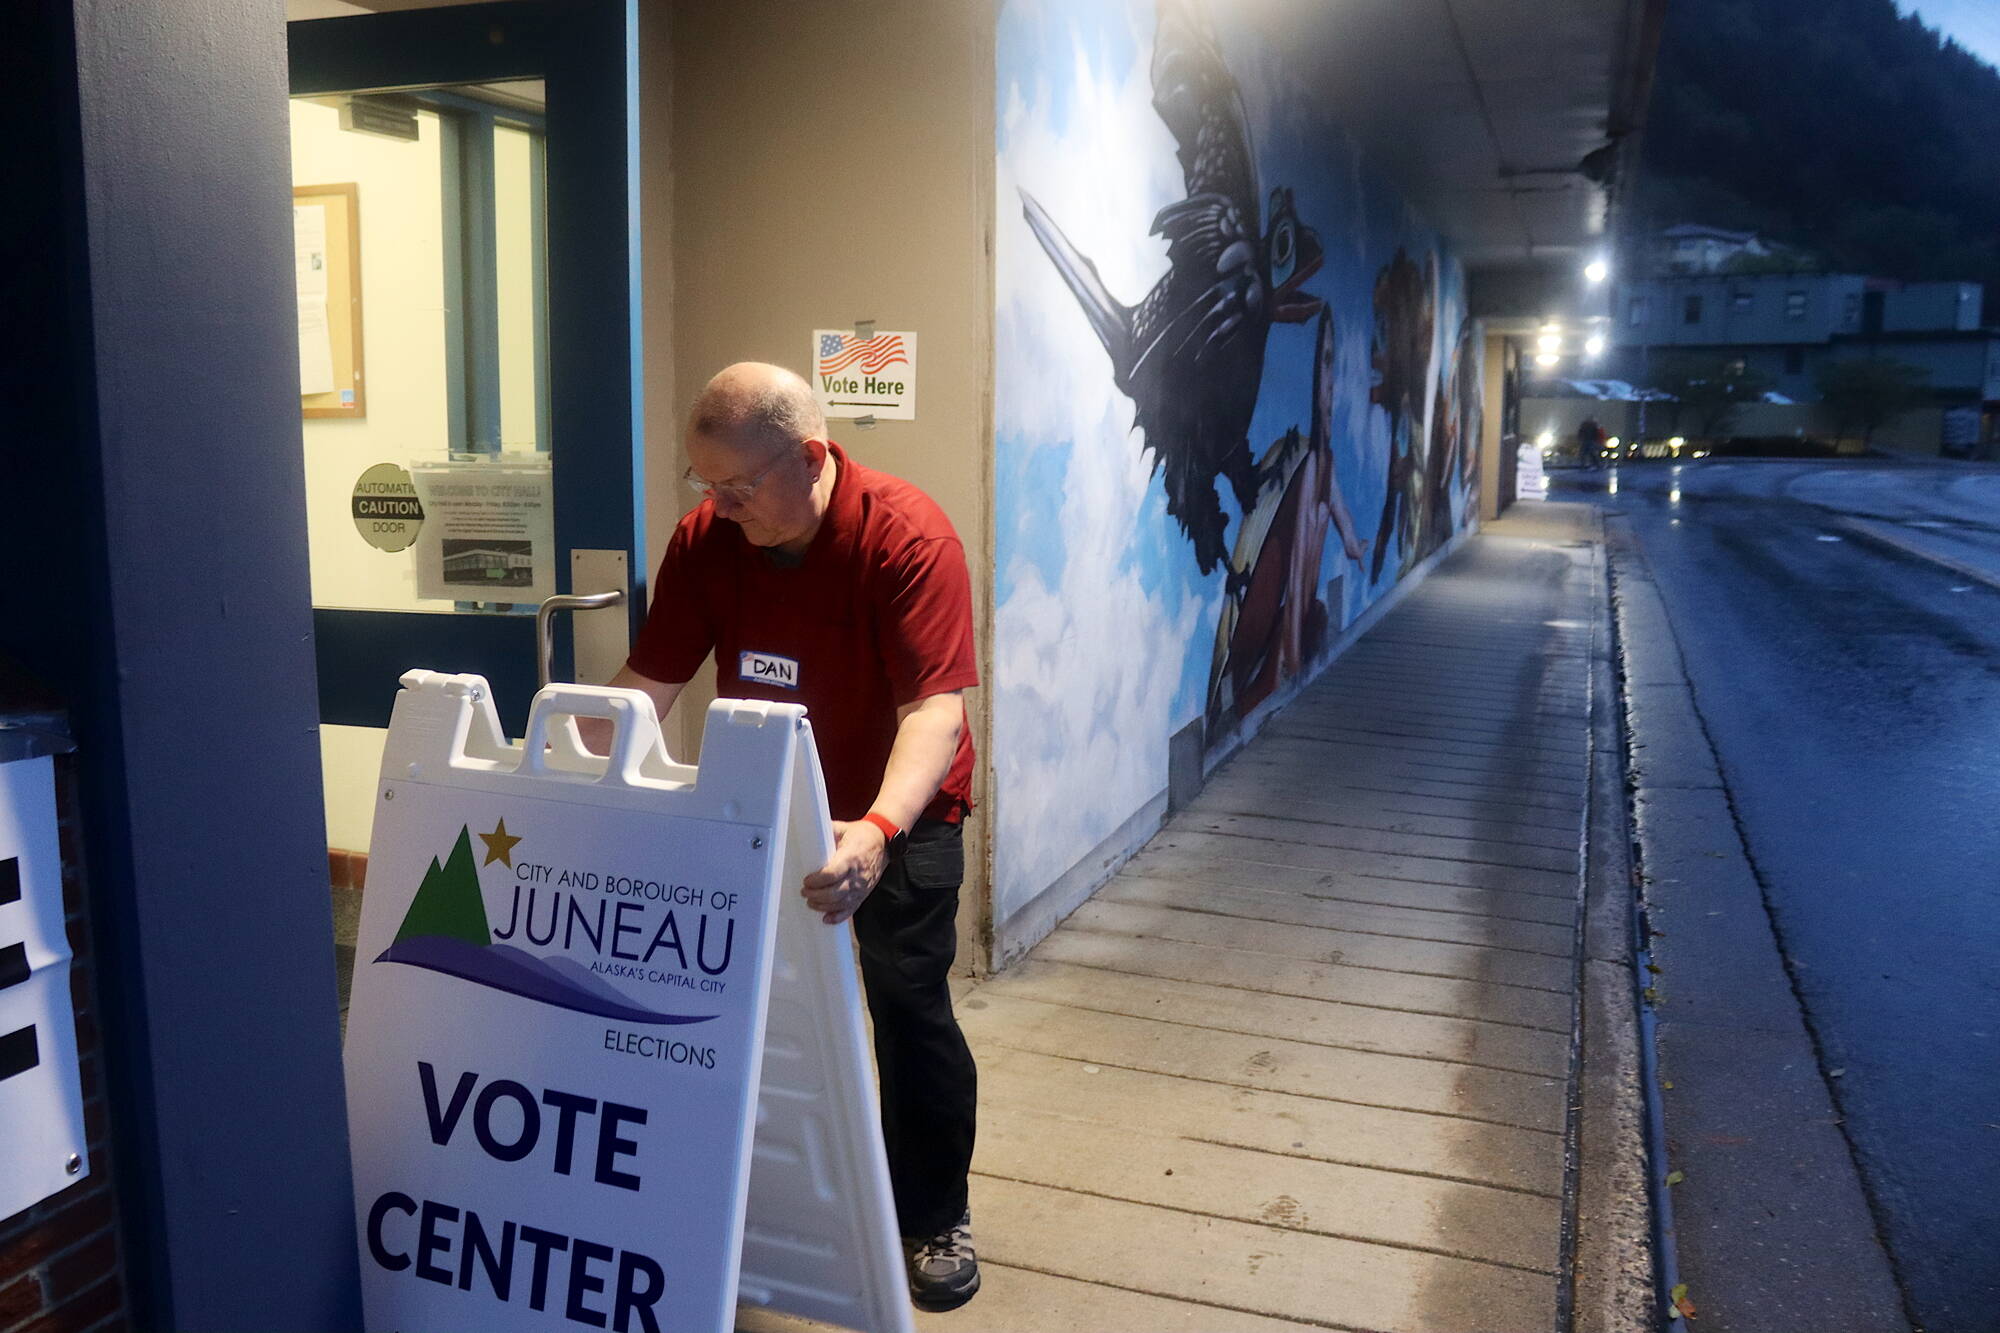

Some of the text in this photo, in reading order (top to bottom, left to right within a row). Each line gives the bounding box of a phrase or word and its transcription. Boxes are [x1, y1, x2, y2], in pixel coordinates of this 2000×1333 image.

[821, 375, 905, 395] Vote Here
[358, 500, 419, 515] CAUTION
[372, 521, 406, 534] DOOR
[753, 658, 792, 681] DAN
[516, 862, 738, 912] CITY AND BOROUGH OF
[493, 885, 735, 976] JUNEAU
[590, 960, 727, 994] ALASKA'S CAPITAL CITY
[604, 1029, 716, 1070] ELECTIONS
[417, 1060, 649, 1193] VOTE
[366, 1191, 666, 1333] CENTER
